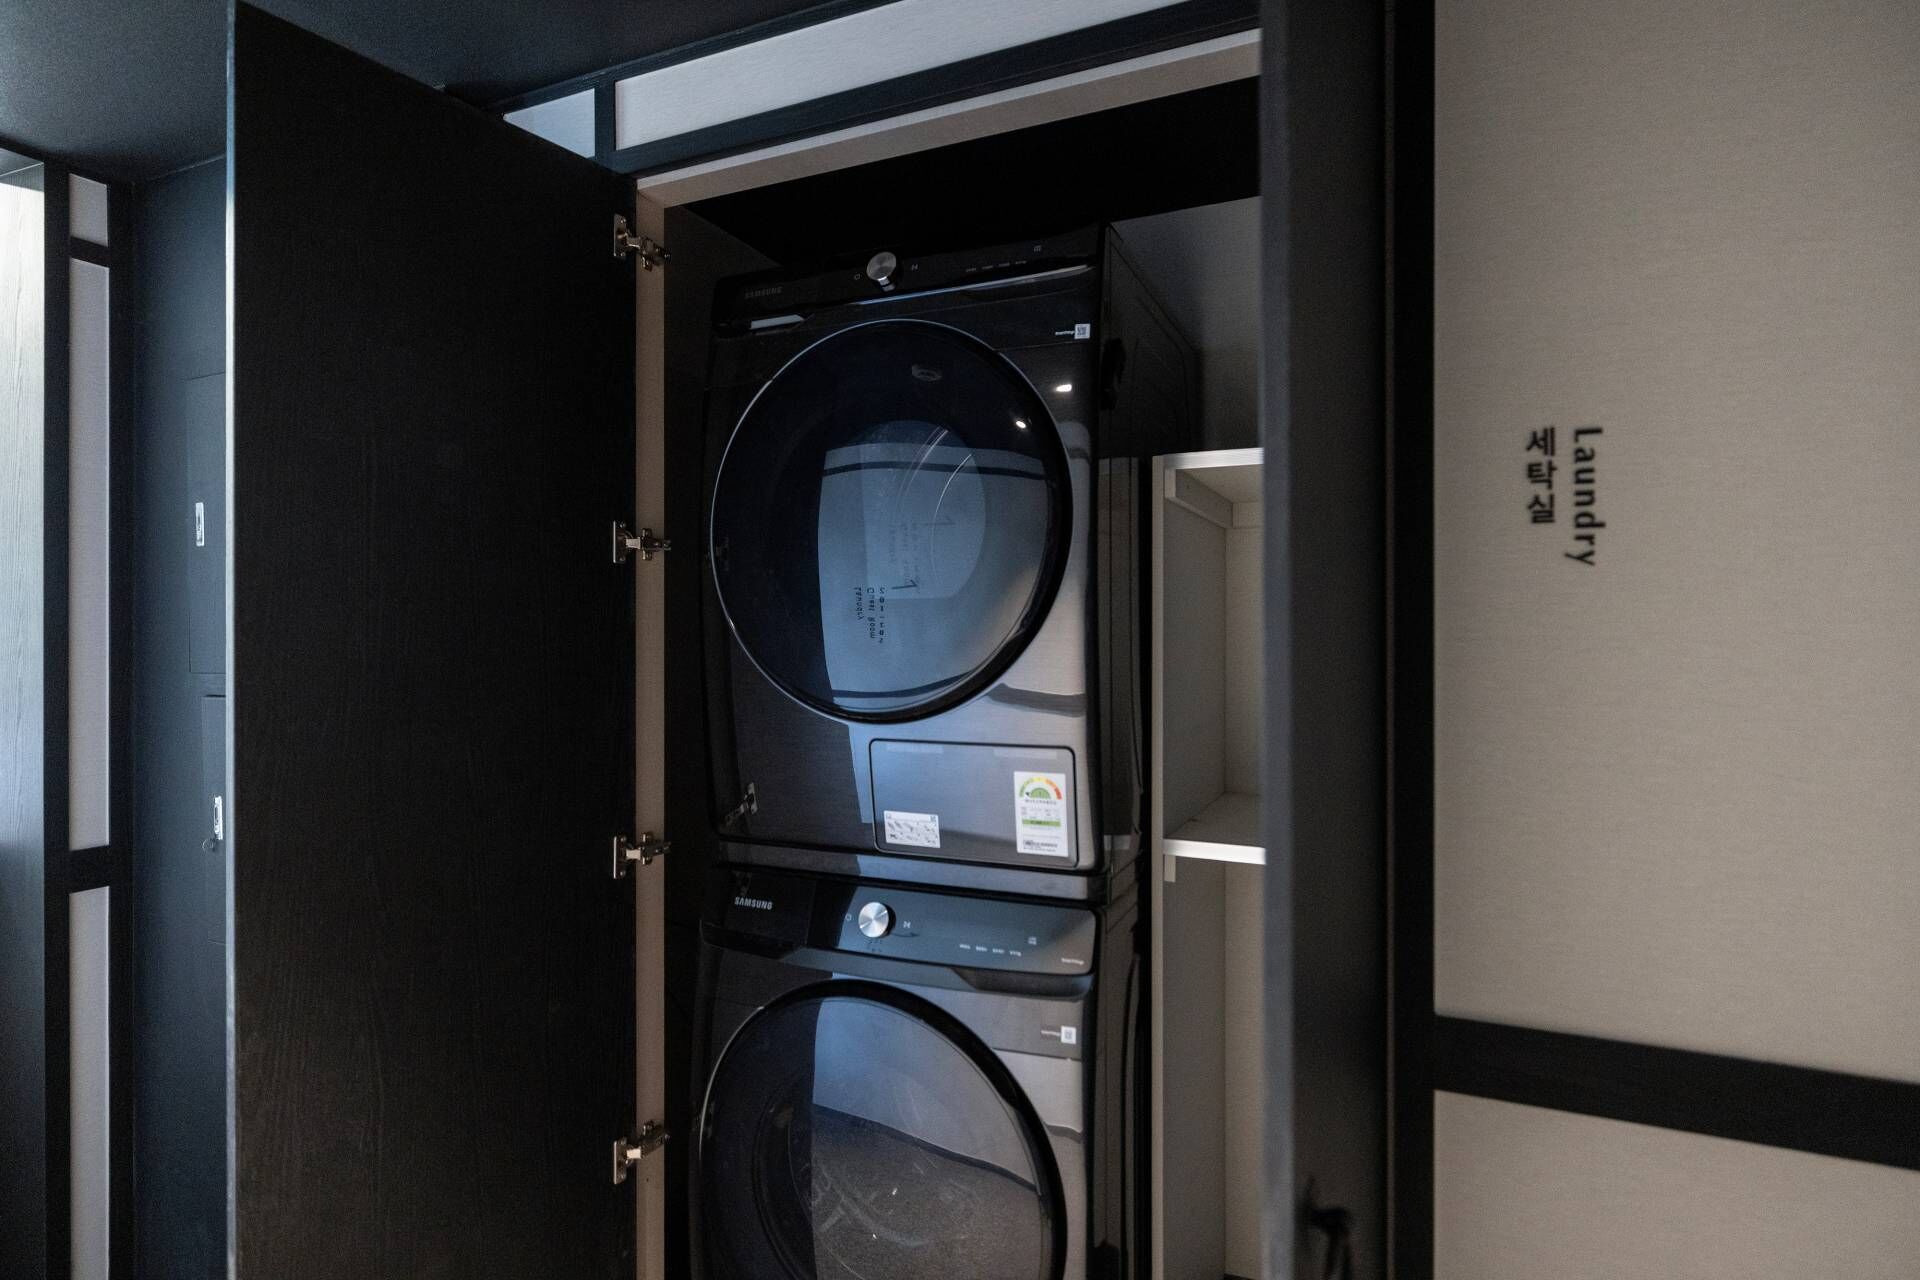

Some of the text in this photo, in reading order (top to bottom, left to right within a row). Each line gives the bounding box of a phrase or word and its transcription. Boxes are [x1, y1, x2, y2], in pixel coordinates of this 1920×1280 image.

[1526, 426, 1558, 524] 세탁실
[1565, 426, 1607, 566] Laundry
[734, 896, 773, 910] SAMSUNG
